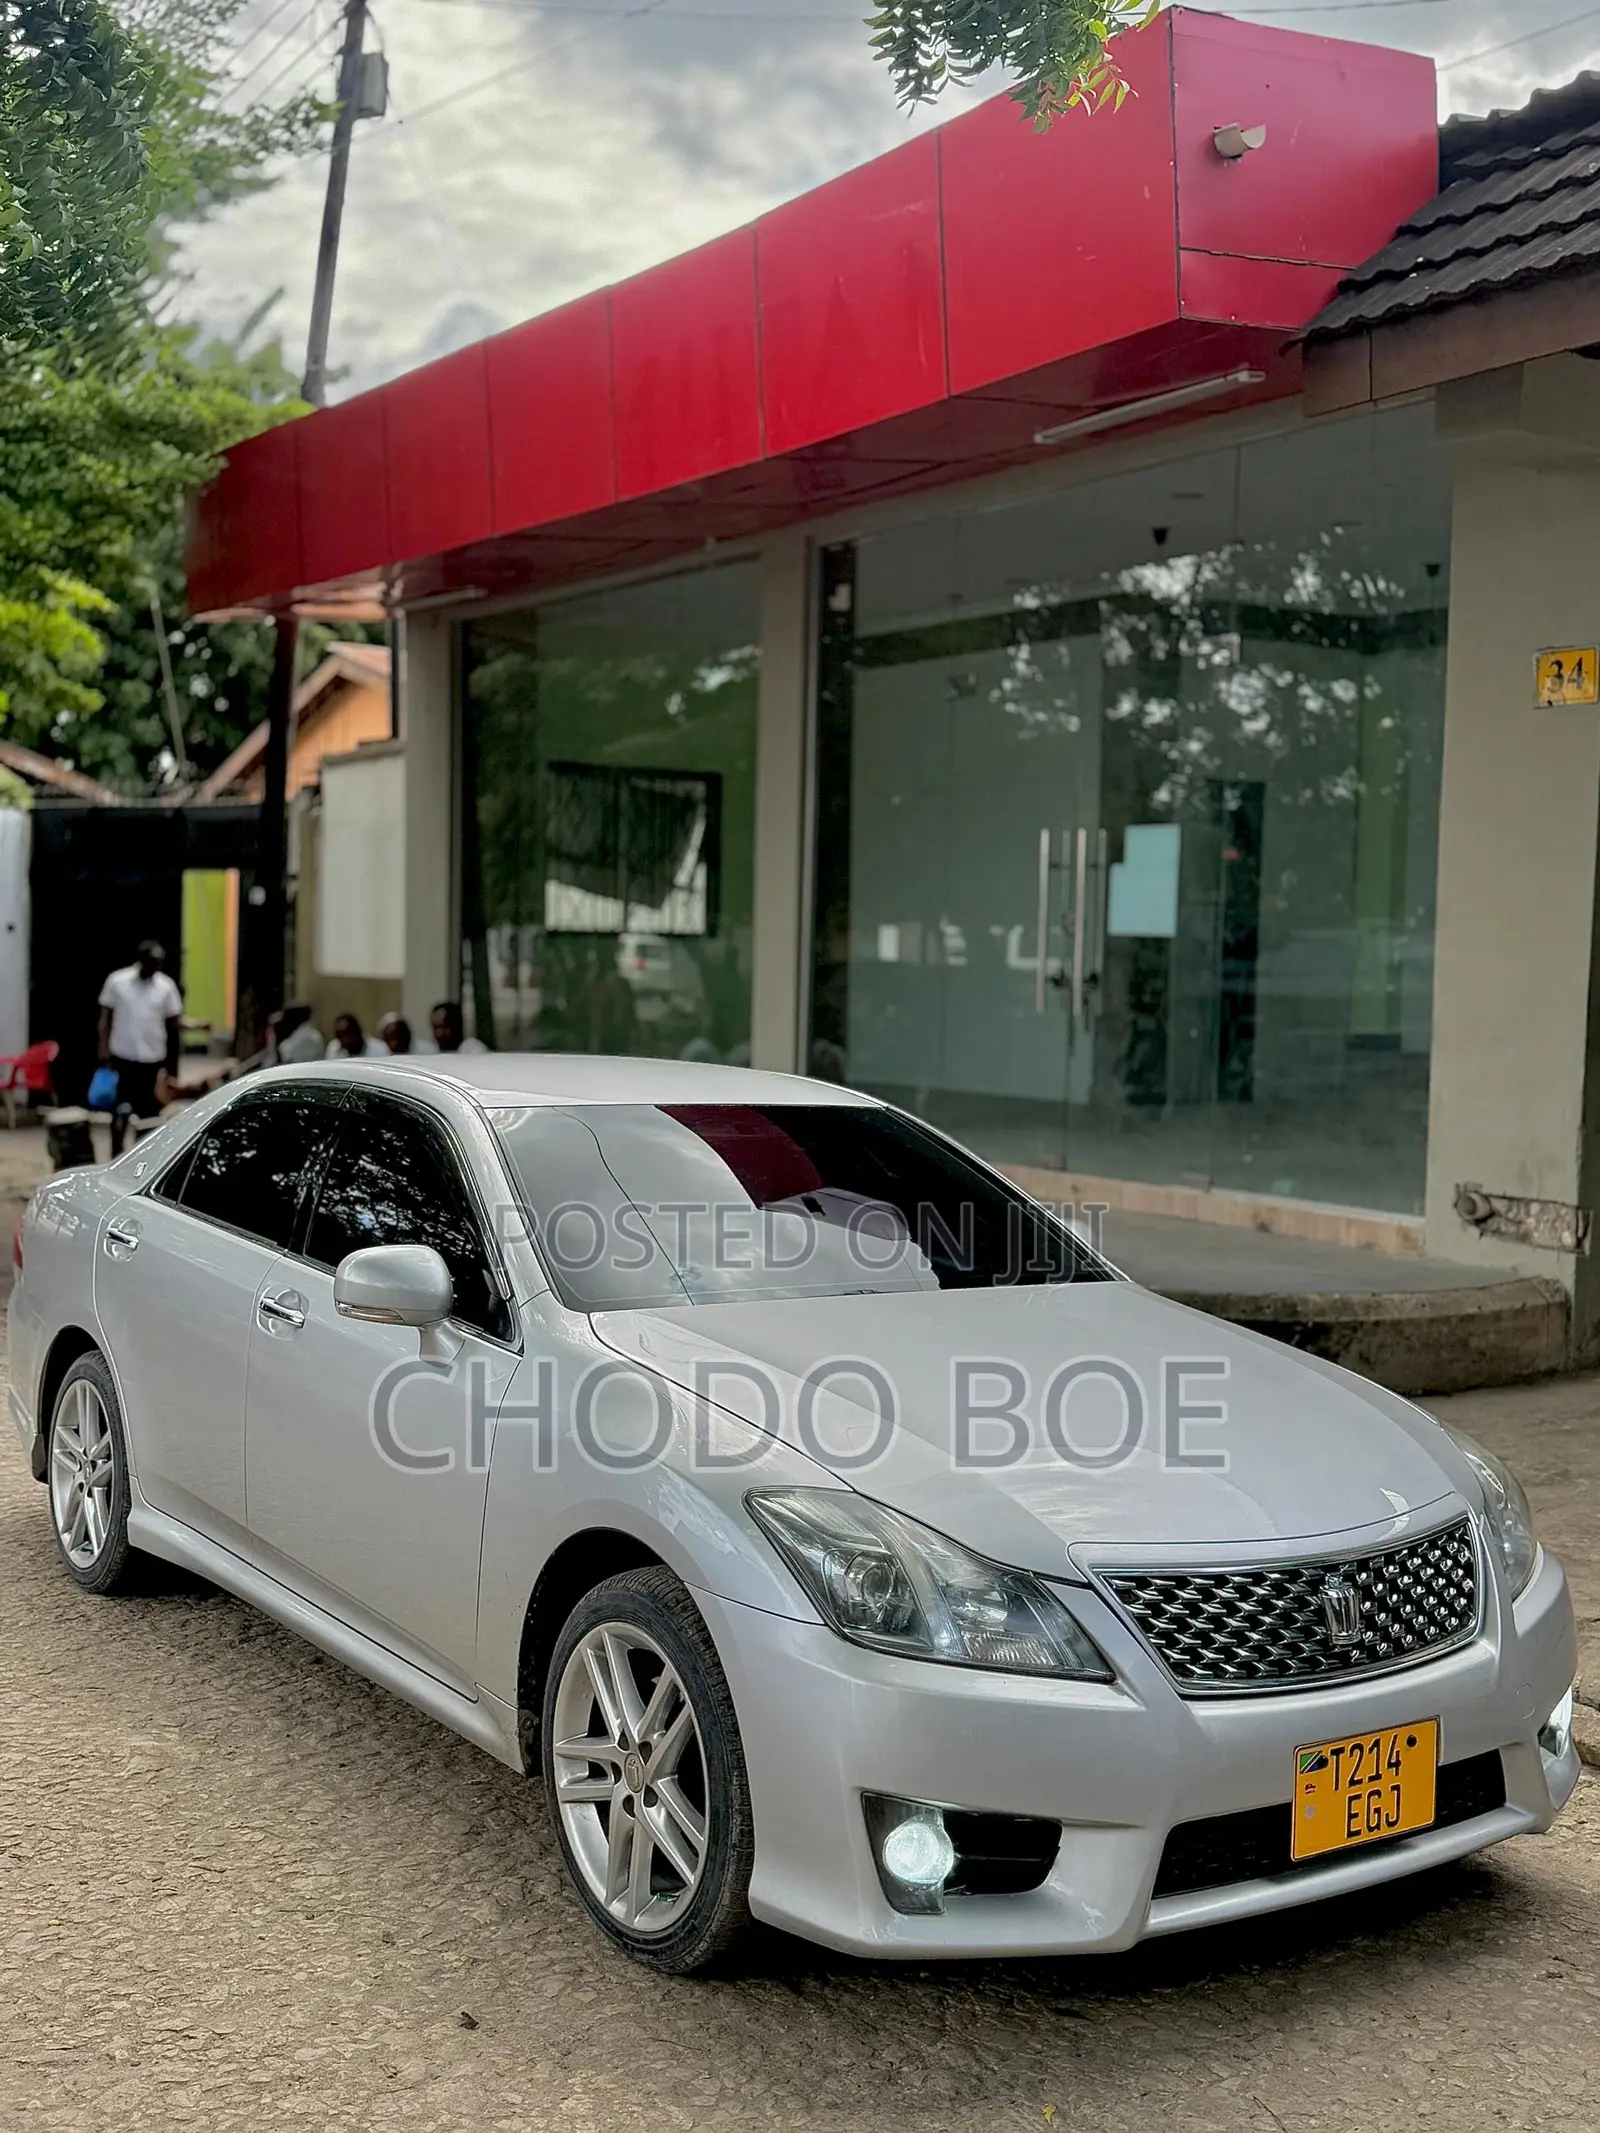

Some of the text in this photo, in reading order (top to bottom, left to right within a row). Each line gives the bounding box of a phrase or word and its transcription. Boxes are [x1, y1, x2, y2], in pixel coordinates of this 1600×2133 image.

[1547, 656, 1585, 693] 34
[1330, 1734, 1402, 1791] T214
[1346, 1784, 1401, 1838] EGJ
